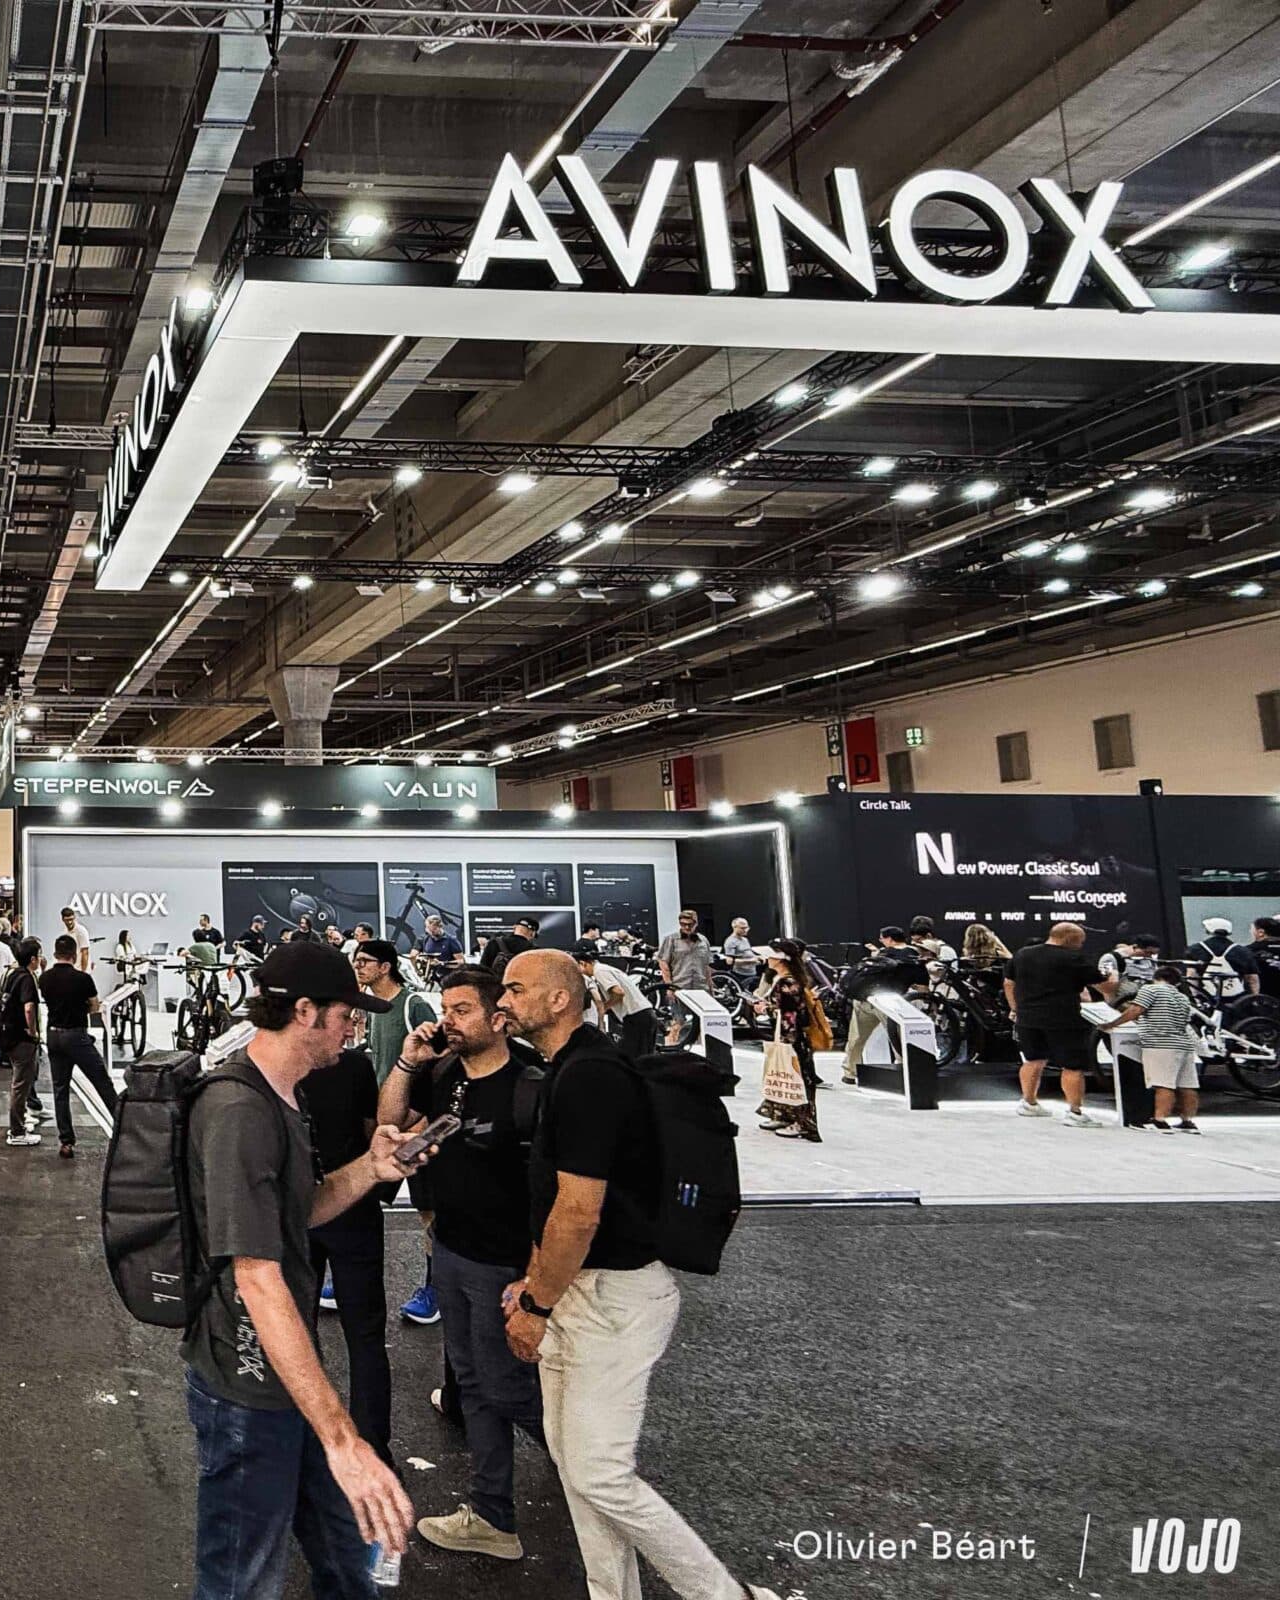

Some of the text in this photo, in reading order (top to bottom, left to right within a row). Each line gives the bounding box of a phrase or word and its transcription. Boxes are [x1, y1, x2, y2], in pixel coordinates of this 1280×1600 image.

[457, 152, 1155, 309] AVINOX
[99, 296, 177, 552] AVINOX
[854, 754, 870, 777] D
[13, 777, 183, 796] STEPPENWOLF
[383, 781, 478, 798] VAUN
[860, 800, 911, 810] Circle Talk
[978, 861, 1024, 877] Power,
[1025, 860, 1070, 875] Classic
[1071, 861, 1100, 875] Soul
[69, 892, 169, 916] AVINOX
[1077, 890, 1127, 906] Concept
